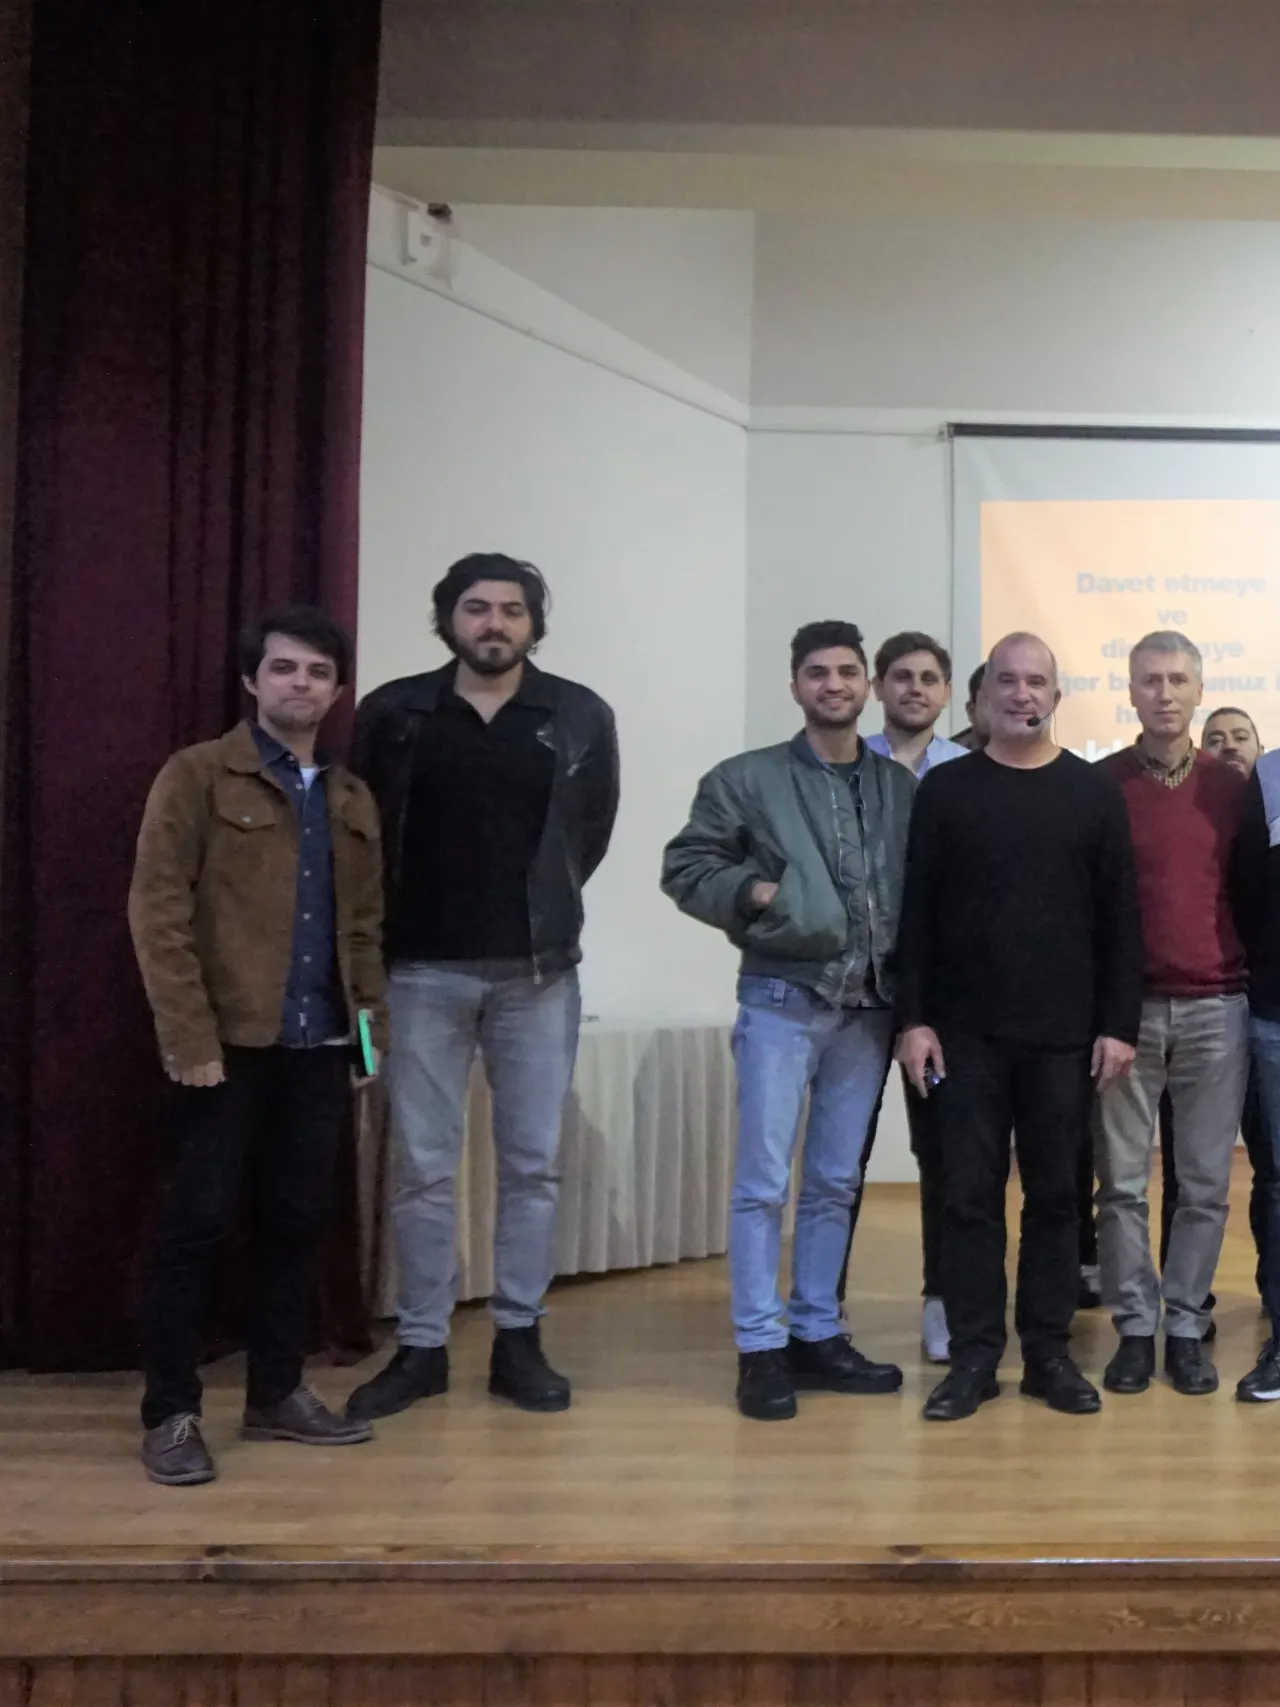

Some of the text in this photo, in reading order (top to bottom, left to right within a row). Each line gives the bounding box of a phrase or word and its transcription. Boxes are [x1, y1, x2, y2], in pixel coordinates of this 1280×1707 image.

[1076, 572, 1267, 597] Davet etmeye
[1156, 608, 1188, 625] ve
